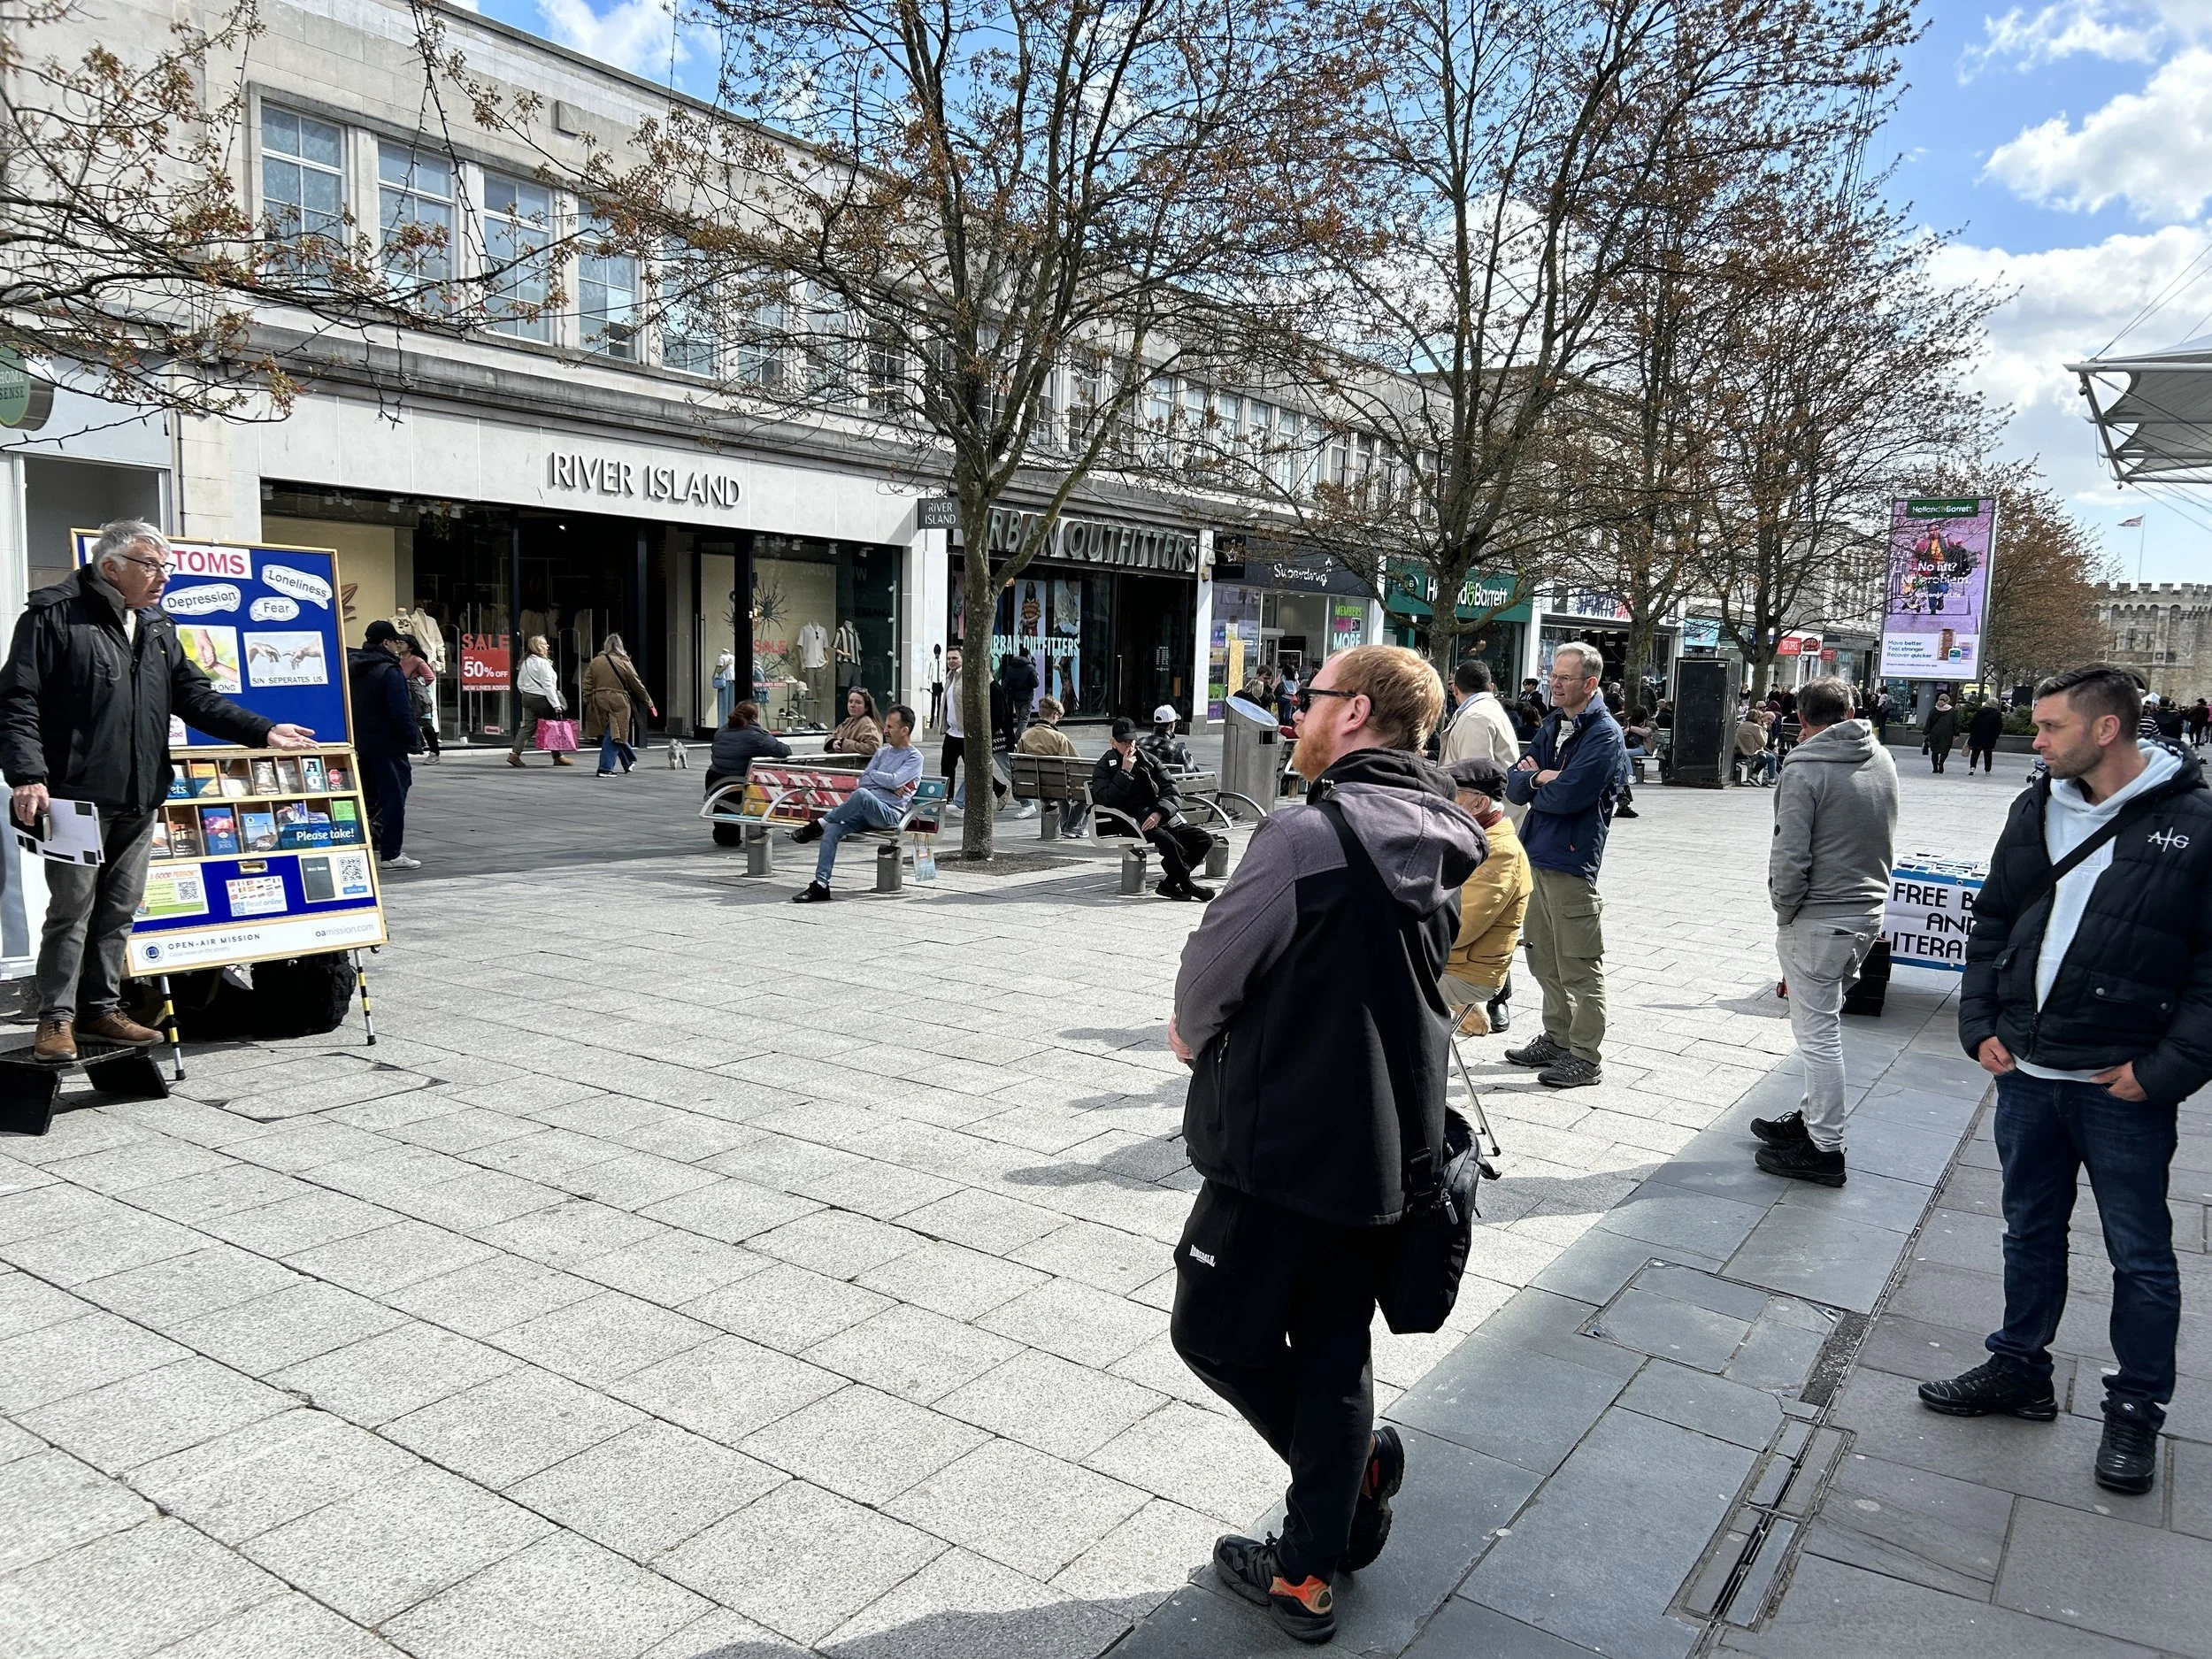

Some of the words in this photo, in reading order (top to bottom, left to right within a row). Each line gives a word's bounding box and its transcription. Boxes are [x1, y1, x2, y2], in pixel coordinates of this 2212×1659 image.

[0, 371, 24, 384] HOME
[0, 386, 25, 399] SENSE
[550, 451, 636, 495] RIVER
[647, 465, 742, 507] ISLAND
[928, 503, 953, 513] RIVER
[925, 513, 956, 525] ISLAND
[988, 507, 1062, 557] RBAN
[1064, 520, 1197, 573] OUTFITTERS
[172, 549, 245, 575] TOMS
[1917, 560, 1935, 572] No
[268, 570, 326, 597] Loneliness
[166, 591, 236, 609] Depression
[1474, 582, 1508, 607] Barrett
[263, 603, 290, 613] Fear
[1334, 604, 1363, 618] MEMBERS
[461, 633, 511, 650] SALE
[753, 639, 787, 654] SALE
[1023, 635, 1080, 657] OUTFITTERS
[1333, 632, 1361, 650] MORE
[464, 660, 495, 678] 50%
[268, 676, 311, 685] SEPERATES
[305, 761, 317, 772] A
[296, 830, 328, 842] Please
[329, 827, 355, 840] take!
[1893, 882, 1948, 908] FREE
[315, 923, 374, 938] oamission.com
[167, 939, 217, 950] OPEN-AIR
[219, 933, 261, 944] MISSION
[1891, 931, 1967, 959] ITERA
